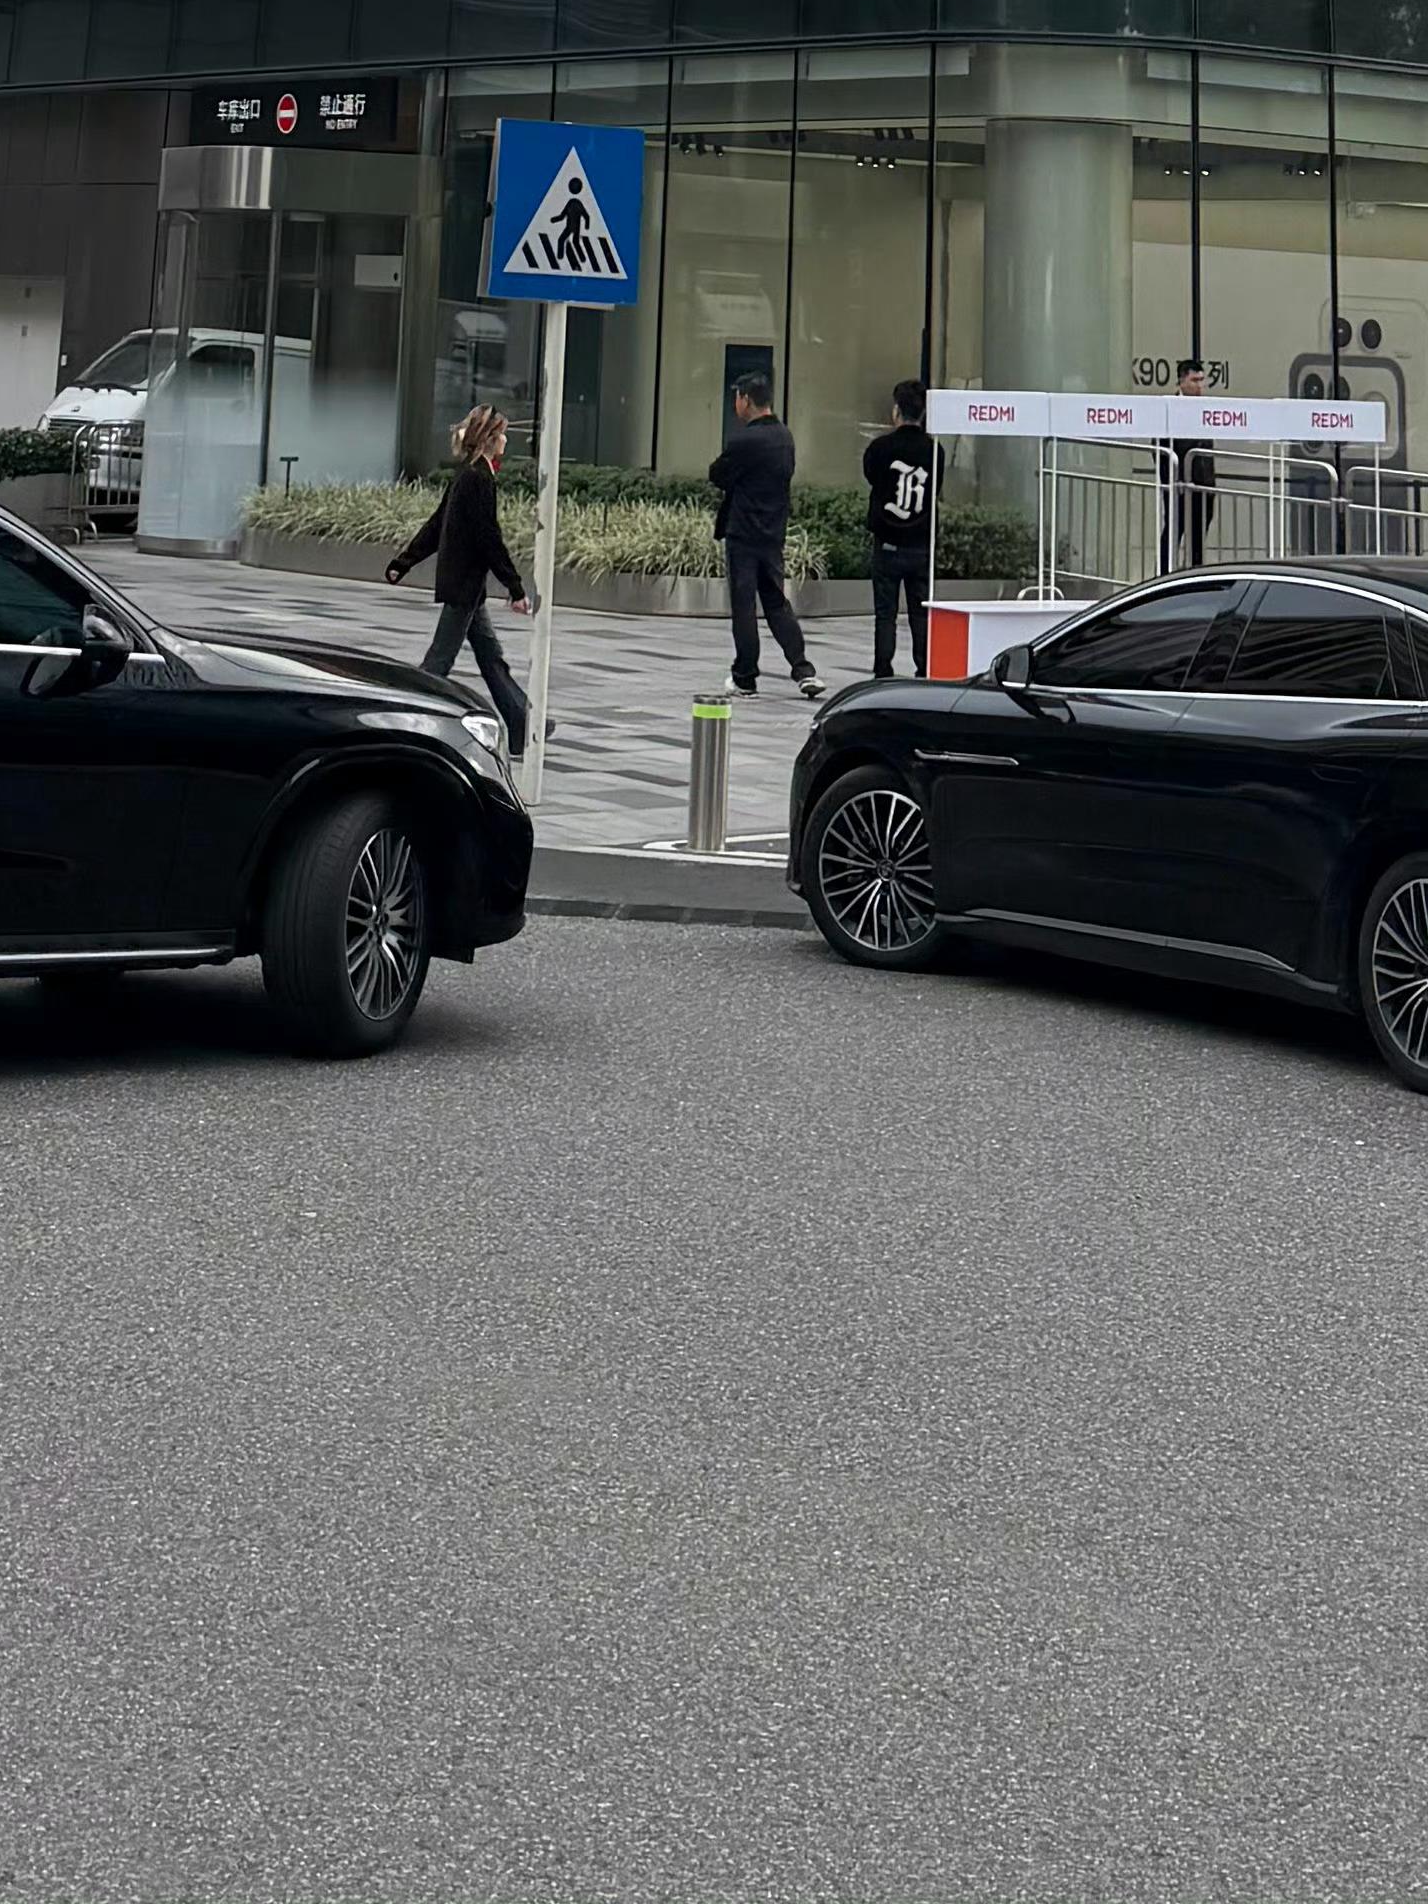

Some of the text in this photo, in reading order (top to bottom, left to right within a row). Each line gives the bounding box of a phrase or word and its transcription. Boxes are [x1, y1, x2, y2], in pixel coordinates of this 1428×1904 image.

[217, 94, 366, 121] 车库出口 禁止通行
[1132, 357, 1229, 390] 90列
[968, 404, 1015, 422] REDMI
[1086, 407, 1133, 425] REDMI
[1202, 410, 1248, 427] REDMI
[1311, 412, 1354, 429] REDMI
